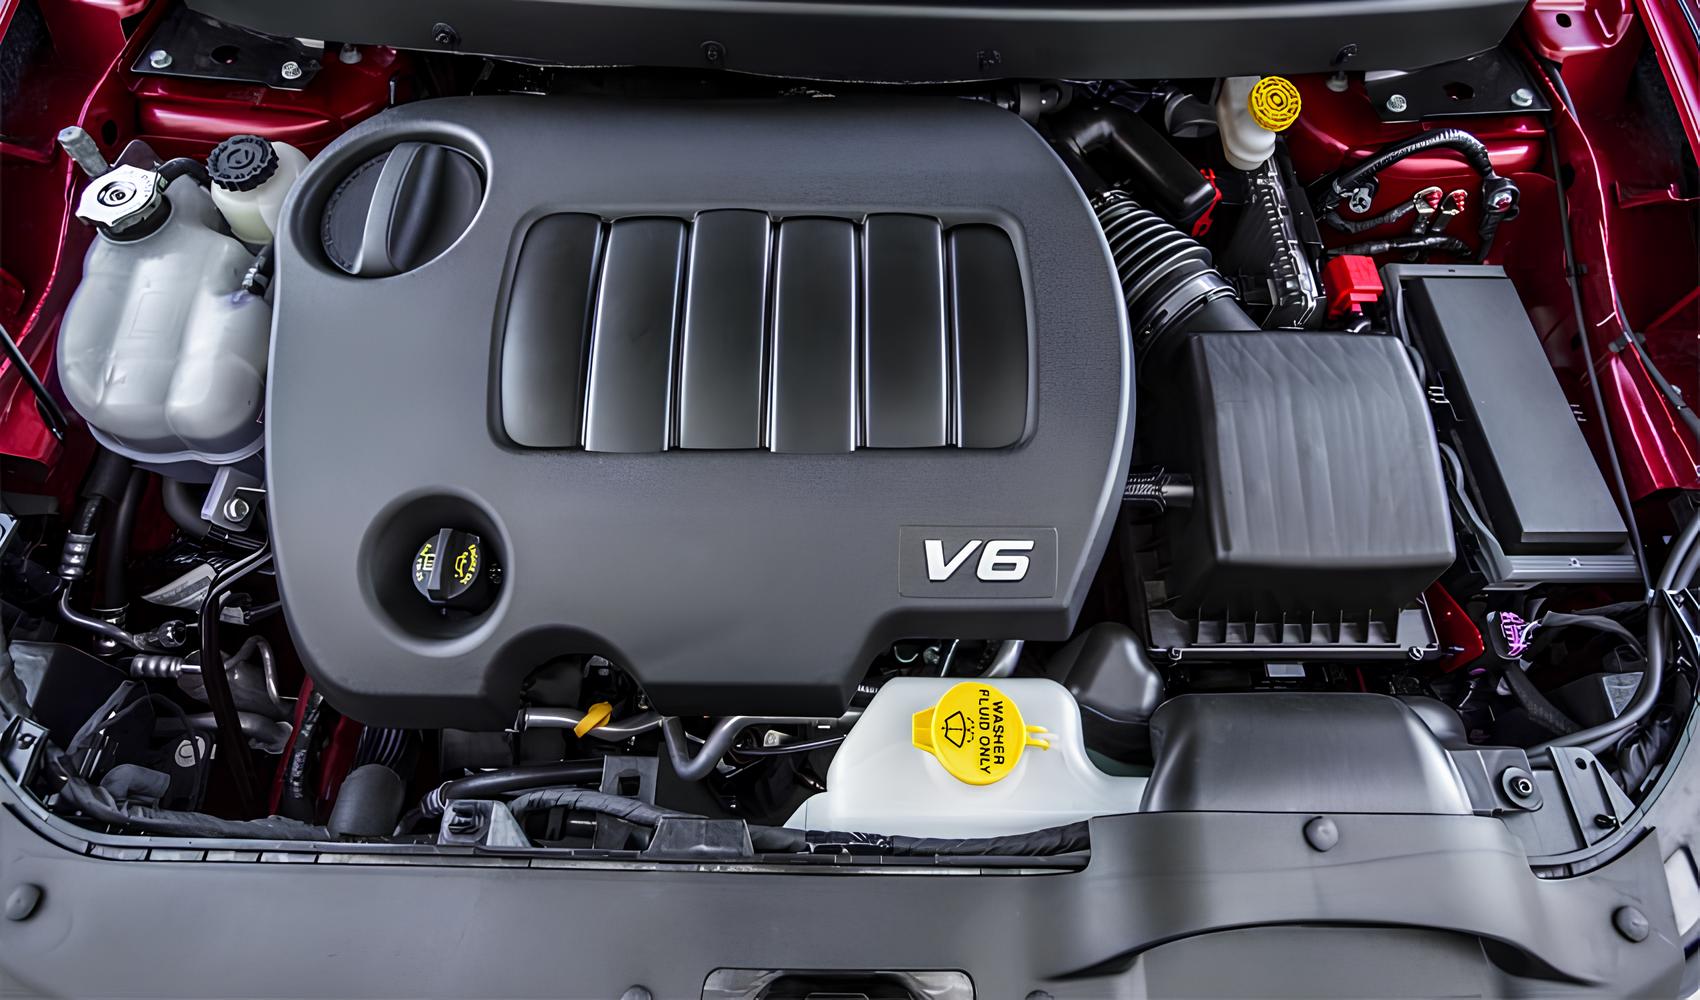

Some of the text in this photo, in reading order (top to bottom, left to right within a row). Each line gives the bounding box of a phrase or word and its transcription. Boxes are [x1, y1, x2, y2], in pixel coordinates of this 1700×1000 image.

[924, 539, 1035, 581] V6
[978, 689, 991, 774] FLUID ONLY
[992, 700, 1005, 765] WASHER
